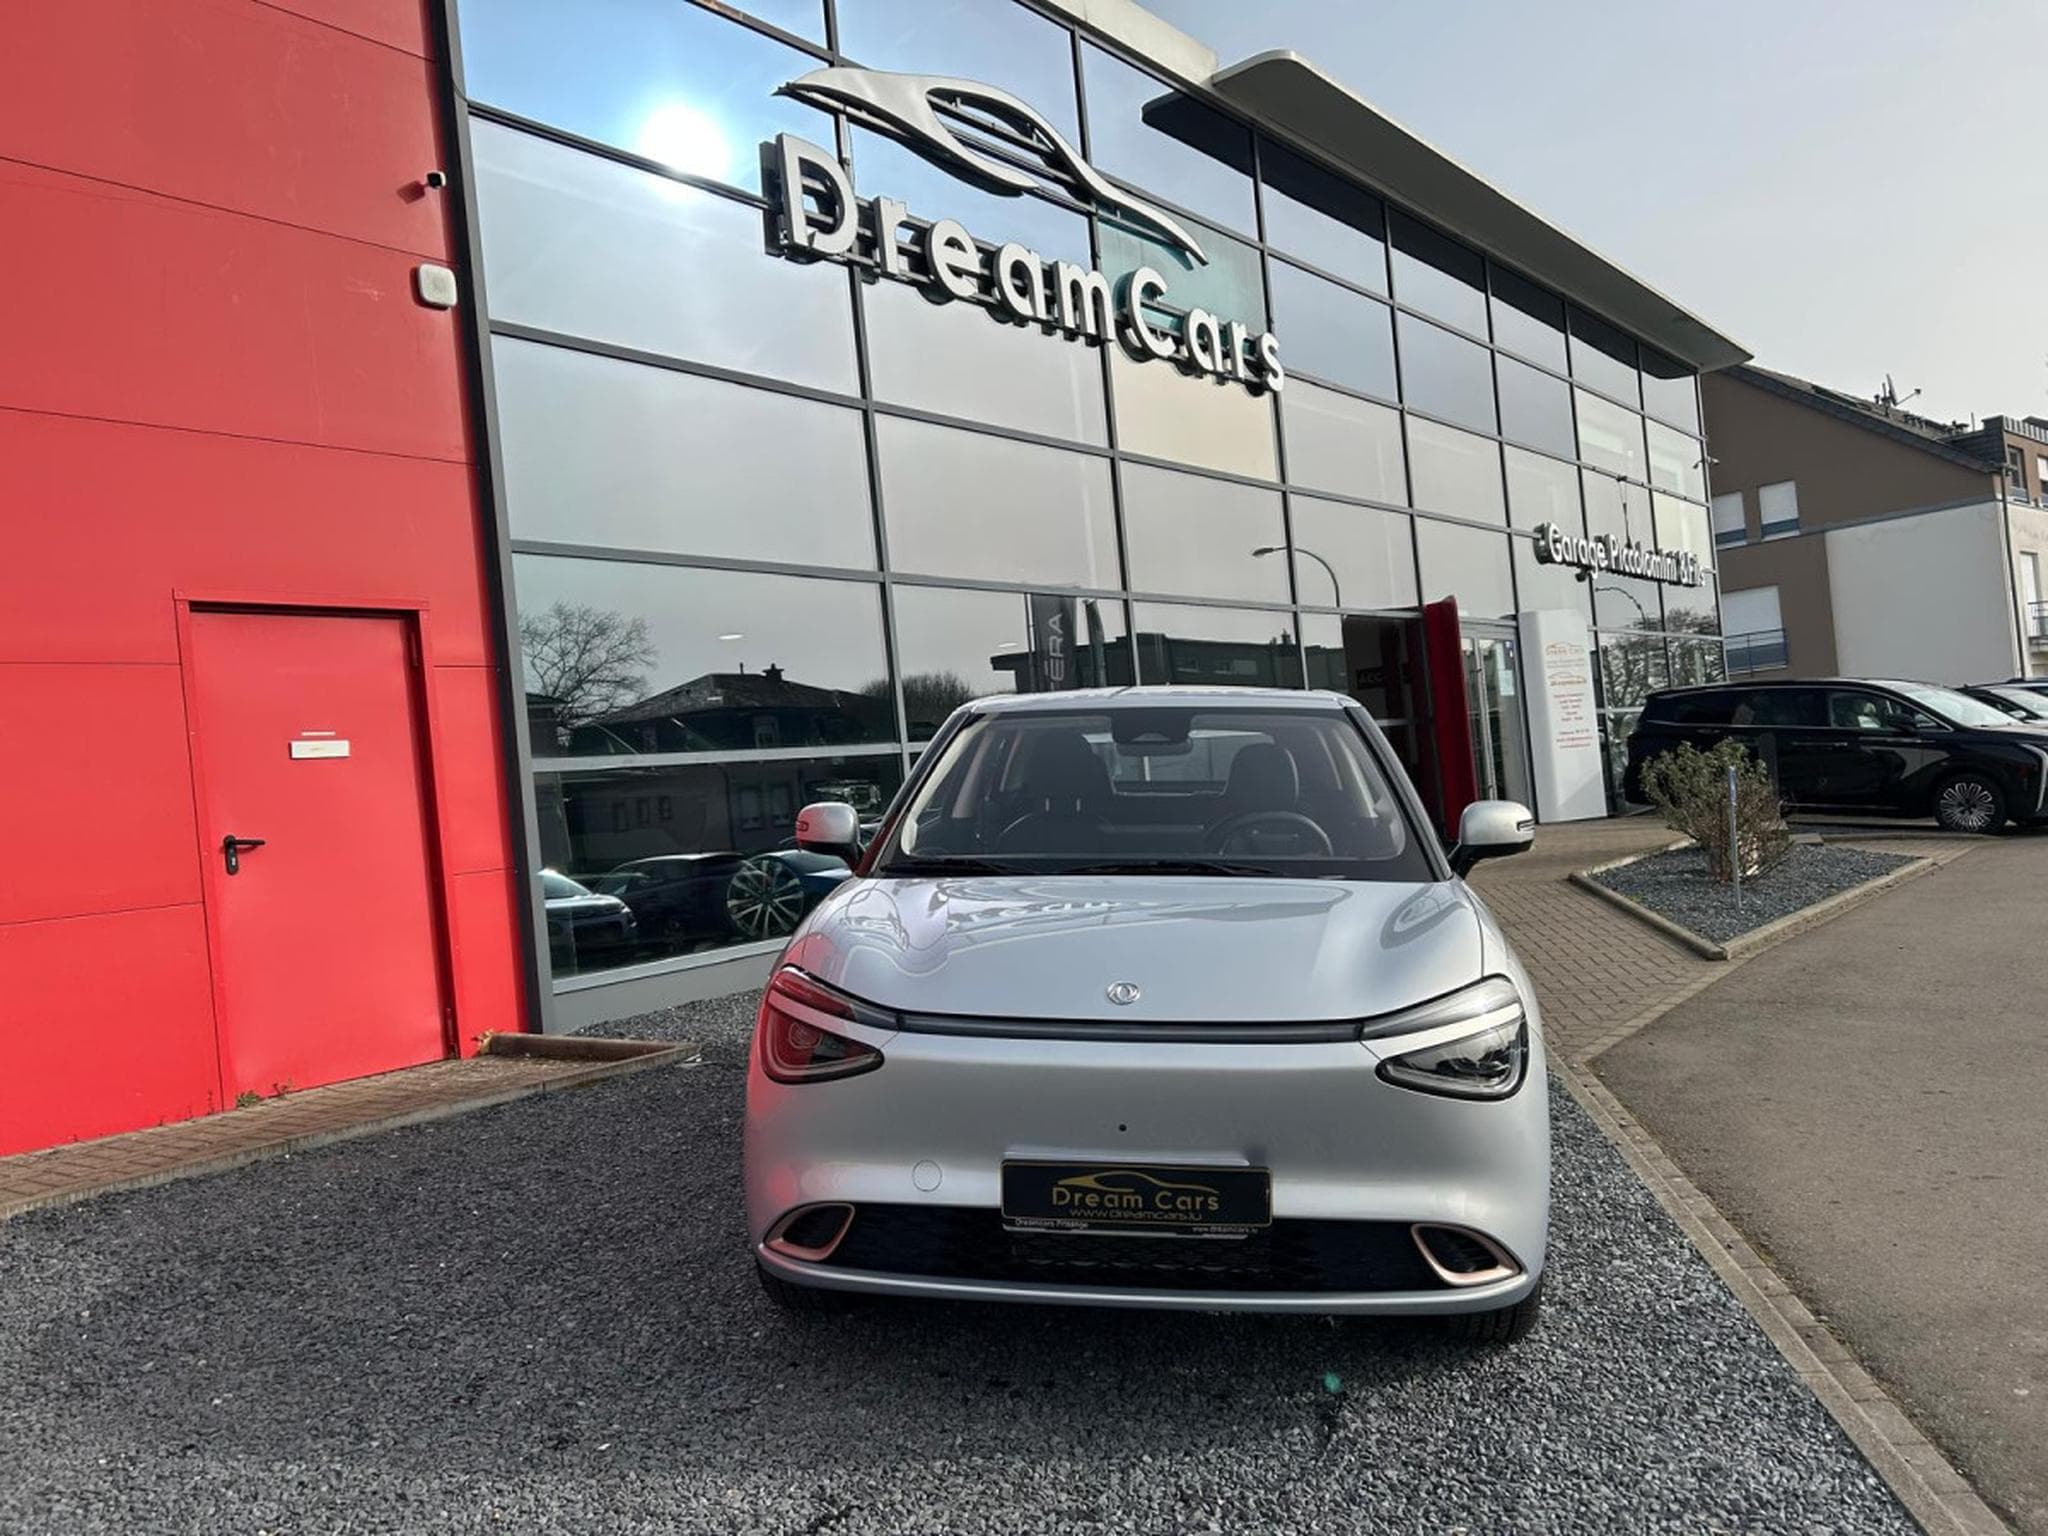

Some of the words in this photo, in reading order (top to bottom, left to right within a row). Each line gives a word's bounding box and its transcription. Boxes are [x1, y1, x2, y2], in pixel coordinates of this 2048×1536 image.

[1550, 523, 1608, 579] Garage
[1052, 1186, 1143, 1209] Dream
[1155, 1190, 1221, 1212] Cars
